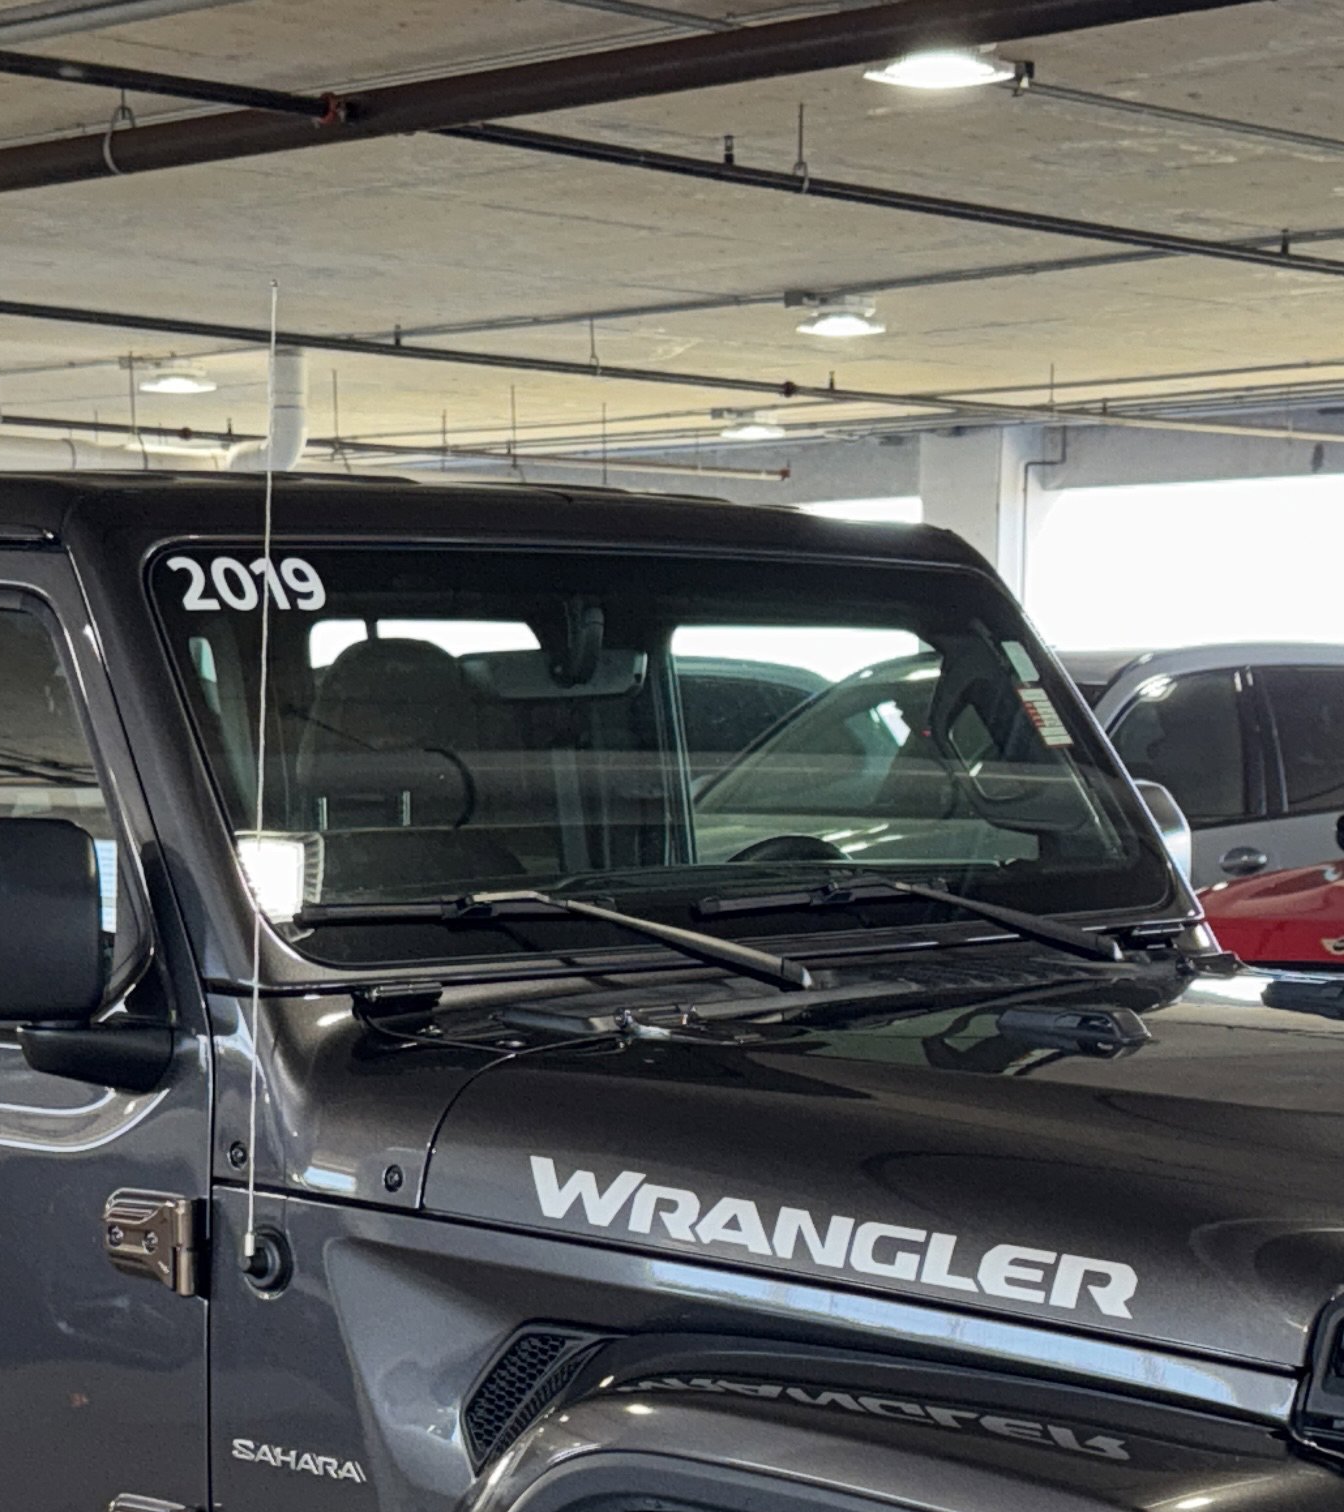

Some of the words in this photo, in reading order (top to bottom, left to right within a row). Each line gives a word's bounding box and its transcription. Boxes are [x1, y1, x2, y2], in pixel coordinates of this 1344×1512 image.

[166, 556, 326, 611] 2019
[529, 1155, 1139, 1320] WRANGLER
[232, 1438, 367, 1483] SAHARA
